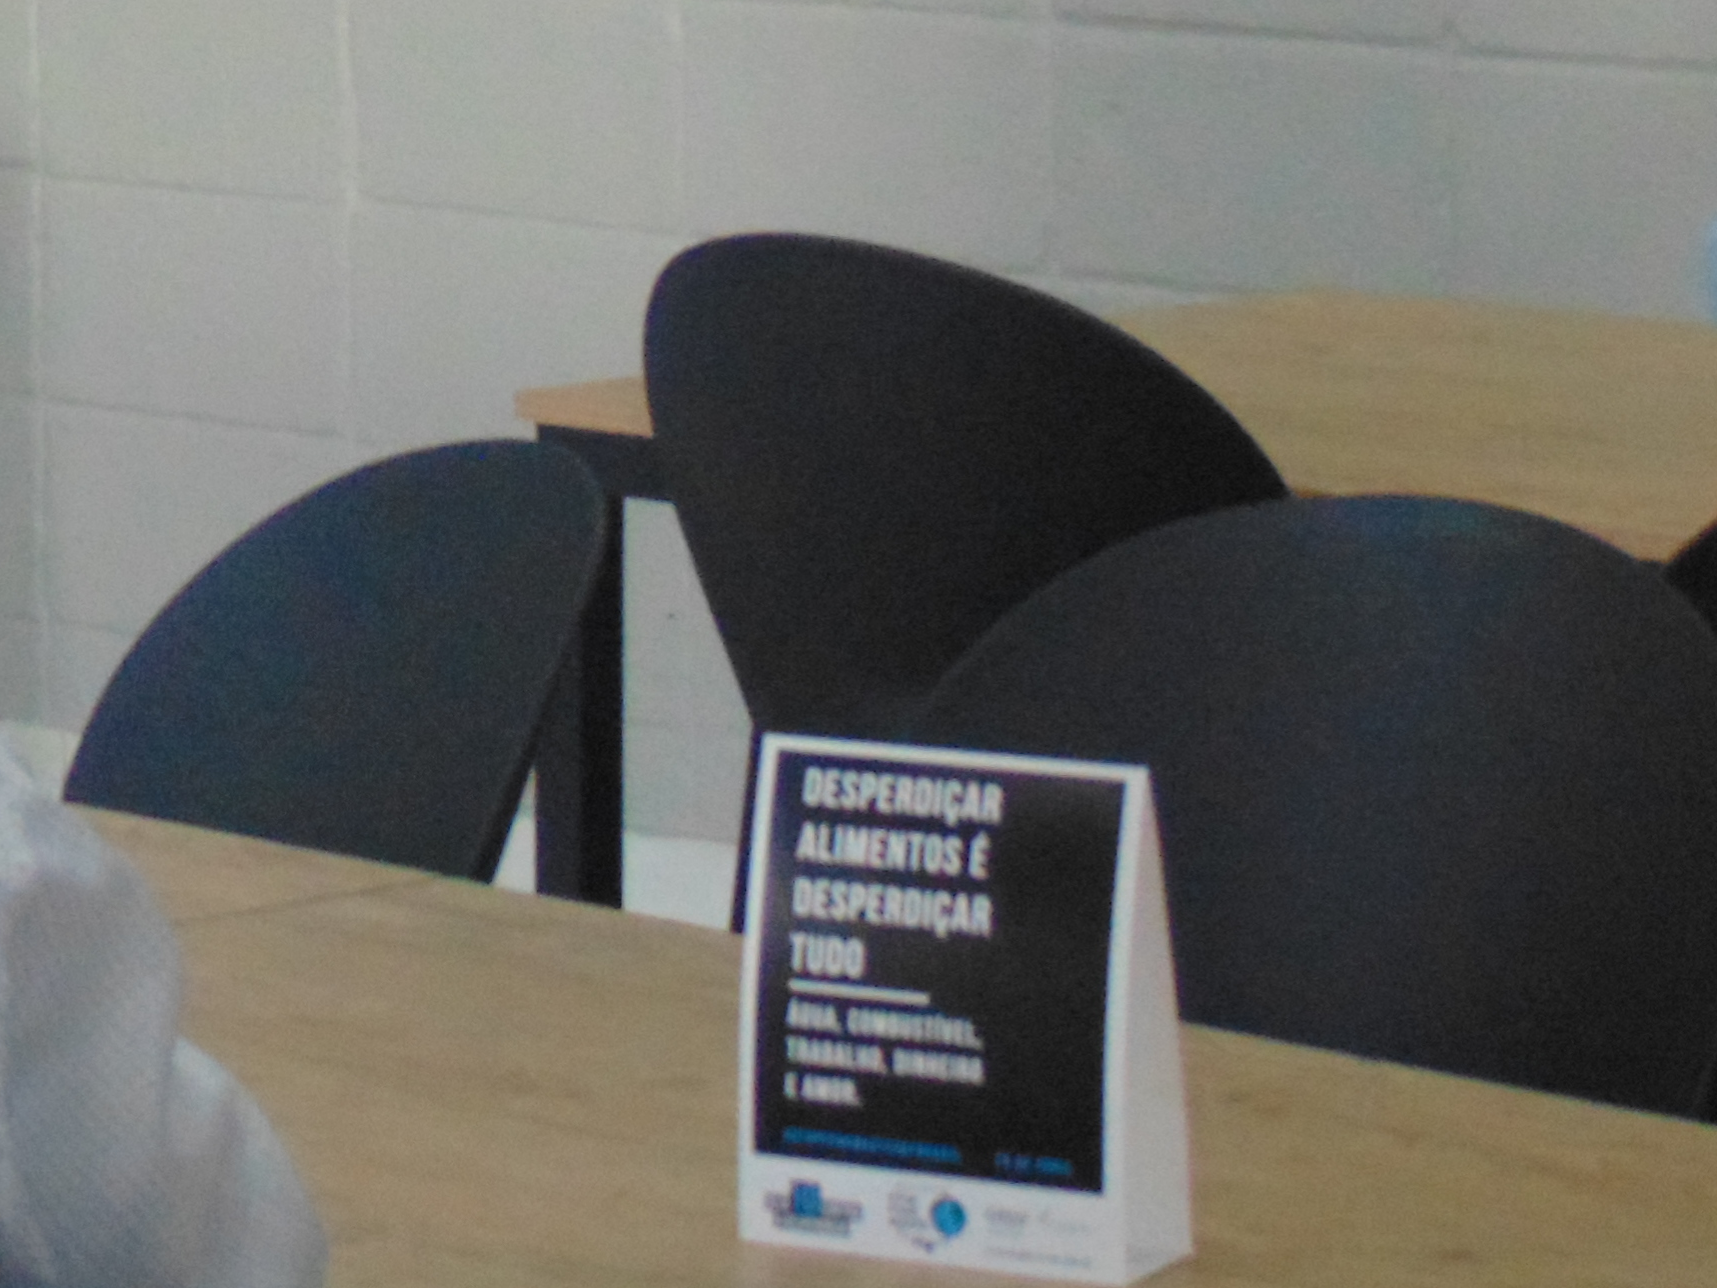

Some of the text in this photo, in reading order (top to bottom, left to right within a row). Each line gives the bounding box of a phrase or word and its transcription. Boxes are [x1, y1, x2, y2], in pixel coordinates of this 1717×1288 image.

[802, 766, 1004, 827] DESPERDIÇAR
[795, 821, 990, 880] ALIMENTOS É
[792, 877, 993, 939] DESPERDIÇAR
[790, 931, 865, 979] TUDO
